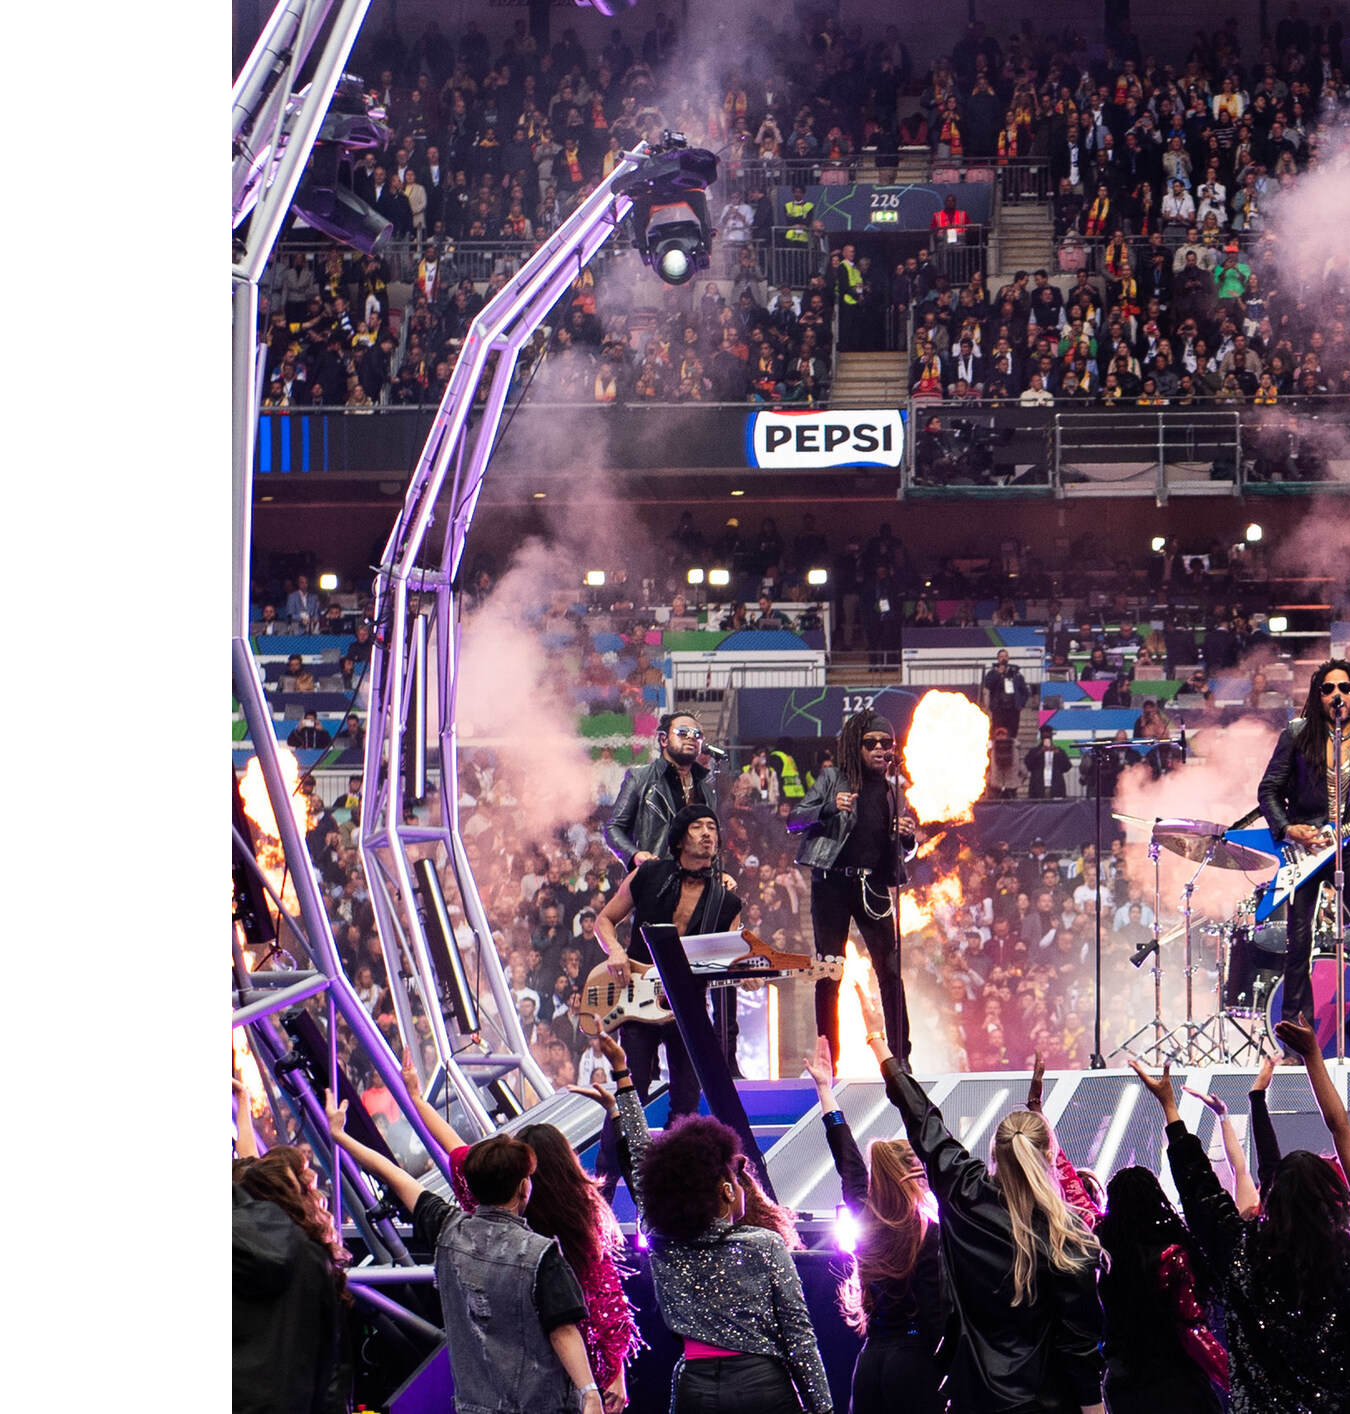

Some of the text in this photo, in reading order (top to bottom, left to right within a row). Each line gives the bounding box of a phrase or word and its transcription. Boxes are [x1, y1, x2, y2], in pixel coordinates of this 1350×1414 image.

[870, 193, 900, 208] 226
[765, 423, 892, 453] PEPSI
[842, 695, 875, 712] 122
